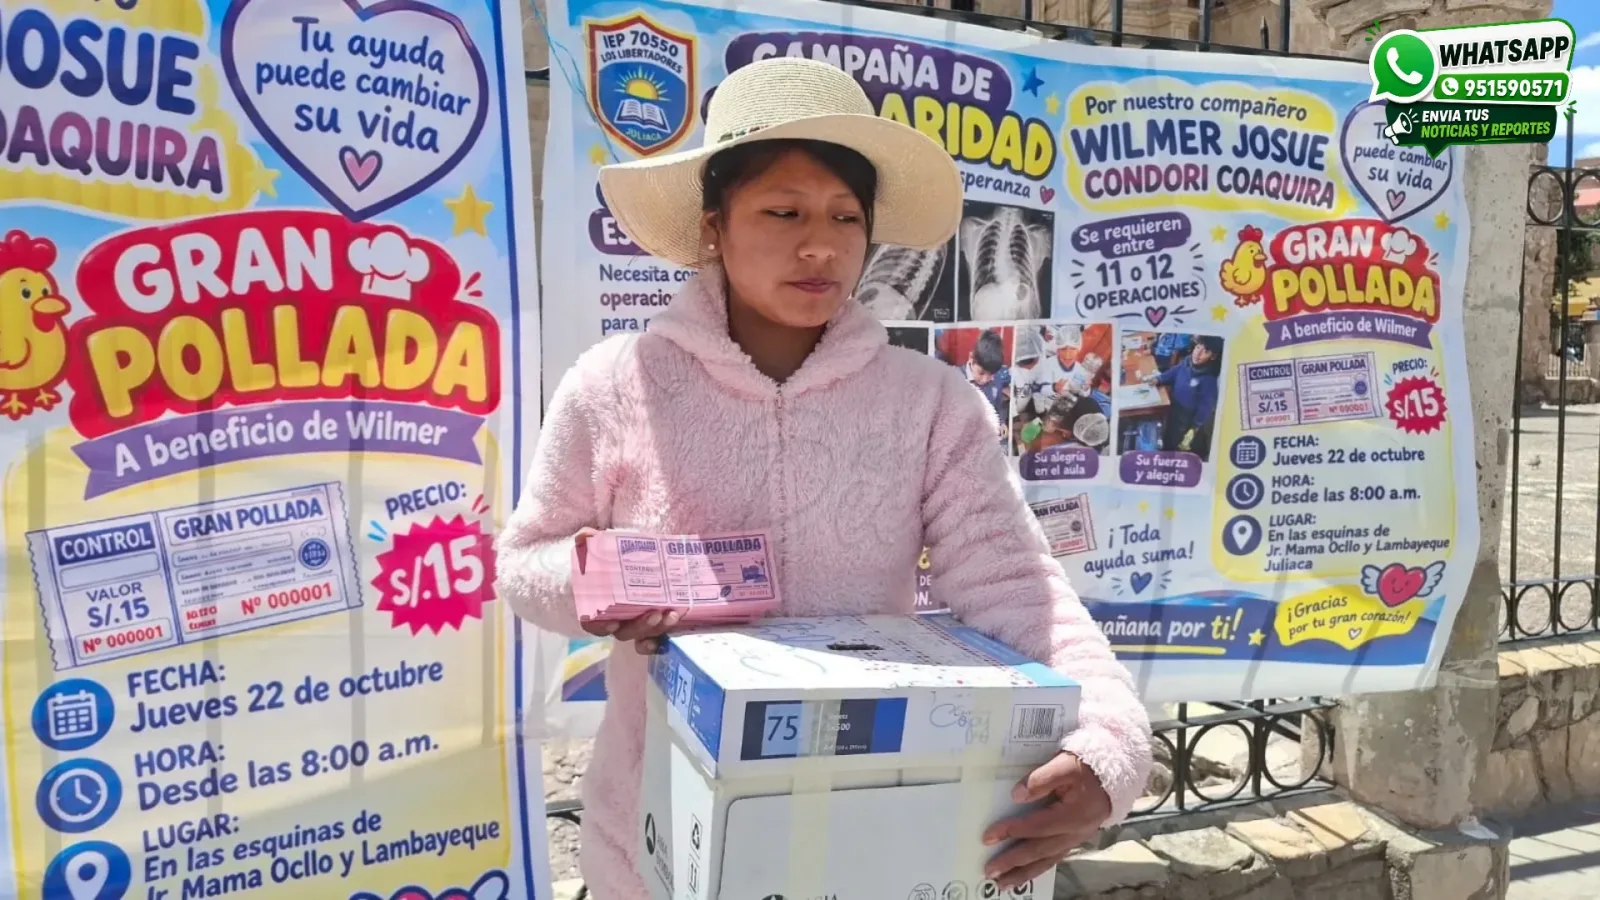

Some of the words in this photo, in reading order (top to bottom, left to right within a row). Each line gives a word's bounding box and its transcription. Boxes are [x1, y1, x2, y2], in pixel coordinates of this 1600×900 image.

[292, 16, 334, 52] Tu
[347, 35, 445, 74] ayuda
[603, 33, 625, 48] IEP
[630, 31, 679, 57] 70550
[0, 8, 199, 116] OSUE
[601, 51, 616, 63] LOS
[618, 49, 683, 74] LIBERTADORES
[256, 58, 346, 95] puede
[356, 73, 471, 116] cambiar
[952, 63, 993, 101] DE
[1084, 94, 1117, 116] Por
[1124, 92, 1194, 111] nuestro
[1200, 94, 1307, 121] compañero
[294, 104, 342, 134] su
[357, 105, 440, 154] vida
[625, 128, 662, 141] JULIACA
[879, 93, 1054, 176] ARIDAD
[1373, 122, 1388, 140] T
[0, 104, 223, 194] AQUIRA
[1070, 118, 1222, 165] WILMER
[1232, 124, 1329, 171] JOSUE
[1353, 144, 1395, 162] puede
[1084, 163, 1208, 200] CONDORI
[1216, 165, 1335, 209] COAQUIRA
[1368, 167, 1389, 182] su
[1397, 168, 1432, 191] vida
[1079, 229, 1099, 246] Se
[1104, 218, 1182, 241] requieren
[1113, 238, 1155, 254] entre
[1282, 225, 1375, 264] GRAN
[114, 226, 333, 313] GRAN
[599, 264, 670, 282] Necesita
[1096, 260, 1122, 287] 11
[1130, 266, 1142, 282] o
[1146, 253, 1174, 280] 12
[600, 289, 677, 311] operacio
[1271, 263, 1436, 317] POLLADA
[601, 317, 639, 336] para
[1280, 325, 1291, 341] A
[1296, 317, 1354, 337] beneficio
[1357, 317, 1372, 332] de
[1375, 318, 1417, 338] Wilmer
[87, 304, 487, 417] POLLADA
[1251, 366, 1291, 378] CONTROL
[1301, 362, 1328, 374] GRAN
[1330, 359, 1366, 371] POLLADA
[1392, 358, 1428, 375] PRECIO:
[1258, 400, 1288, 413] S/.15
[1394, 387, 1440, 420] S/.15
[115, 442, 140, 476] A
[145, 415, 294, 466] beneficio
[303, 408, 338, 440] de
[347, 410, 448, 446] Wilmer
[1273, 435, 1319, 449] FECHA:
[1034, 453, 1048, 463] Su
[1050, 452, 1085, 463] alegría
[1035, 467, 1048, 476] en
[1050, 466, 1061, 475] el
[1063, 466, 1085, 475] aula
[1135, 454, 1151, 466] Su
[1152, 456, 1188, 467] fuerza
[1273, 452, 1323, 466] Jueves
[1328, 450, 1345, 464] 22
[1349, 449, 1366, 463] de
[1371, 448, 1425, 462] octubre
[1135, 472, 1144, 482] y
[1146, 470, 1185, 484] alegría
[1271, 475, 1314, 488] HORA:
[385, 481, 467, 520] PRECIO:
[1271, 490, 1318, 505] Desde
[1324, 488, 1345, 502] las
[1349, 486, 1385, 501] 8:00
[1389, 487, 1421, 500] a.m.
[173, 511, 233, 540] GRAN
[237, 497, 323, 527] POLLADA
[1269, 513, 1316, 527] LUGAR:
[61, 528, 151, 559] CONTROL
[667, 541, 701, 555] GRAN
[703, 538, 761, 554] POLLADA
[1268, 529, 1284, 542] En
[1288, 527, 1307, 541] las
[1311, 525, 1369, 543] esquinas
[1373, 524, 1390, 537] de
[1285, 543, 1324, 556] Mama
[1328, 541, 1361, 554] Ocllo
[1362, 541, 1372, 555] y
[1376, 538, 1450, 552] Lambayeque
[390, 534, 485, 608] S/.15
[1084, 550, 1136, 578] ayuda
[1141, 541, 1194, 565] suma!
[1264, 559, 1313, 573] Juliaca
[86, 581, 143, 602] VALOR
[920, 575, 932, 586] DE
[268, 582, 332, 609] 000001
[1287, 595, 1348, 623] ¡Gracias
[87, 597, 150, 628] S/.15
[1167, 620, 1205, 644] por
[1211, 608, 1243, 640] ti!
[1288, 623, 1308, 640] por
[1312, 617, 1325, 629] tu
[1329, 613, 1357, 629] gran
[1360, 610, 1412, 624] corazón!
[106, 625, 163, 648] 000001
[127, 660, 225, 698] FECHA:
[130, 694, 238, 733] Jueves
[248, 681, 284, 712] 22
[294, 675, 329, 705] de
[339, 660, 443, 698] octubre
[768, 716, 798, 741] 75
[135, 740, 225, 778] HORA:
[138, 767, 238, 811] Desde
[248, 760, 292, 788] las
[301, 740, 369, 777] 8:00
[378, 734, 439, 762] a.m.
[143, 813, 239, 852] LUGAR:
[145, 855, 178, 882] En
[187, 847, 225, 872] las
[233, 821, 345, 858] esquinas
[352, 809, 381, 835] de
[182, 868, 262, 900] Mama
[270, 850, 333, 883] Ocllo
[339, 850, 355, 878] y
[362, 820, 500, 866] Lambayeque
